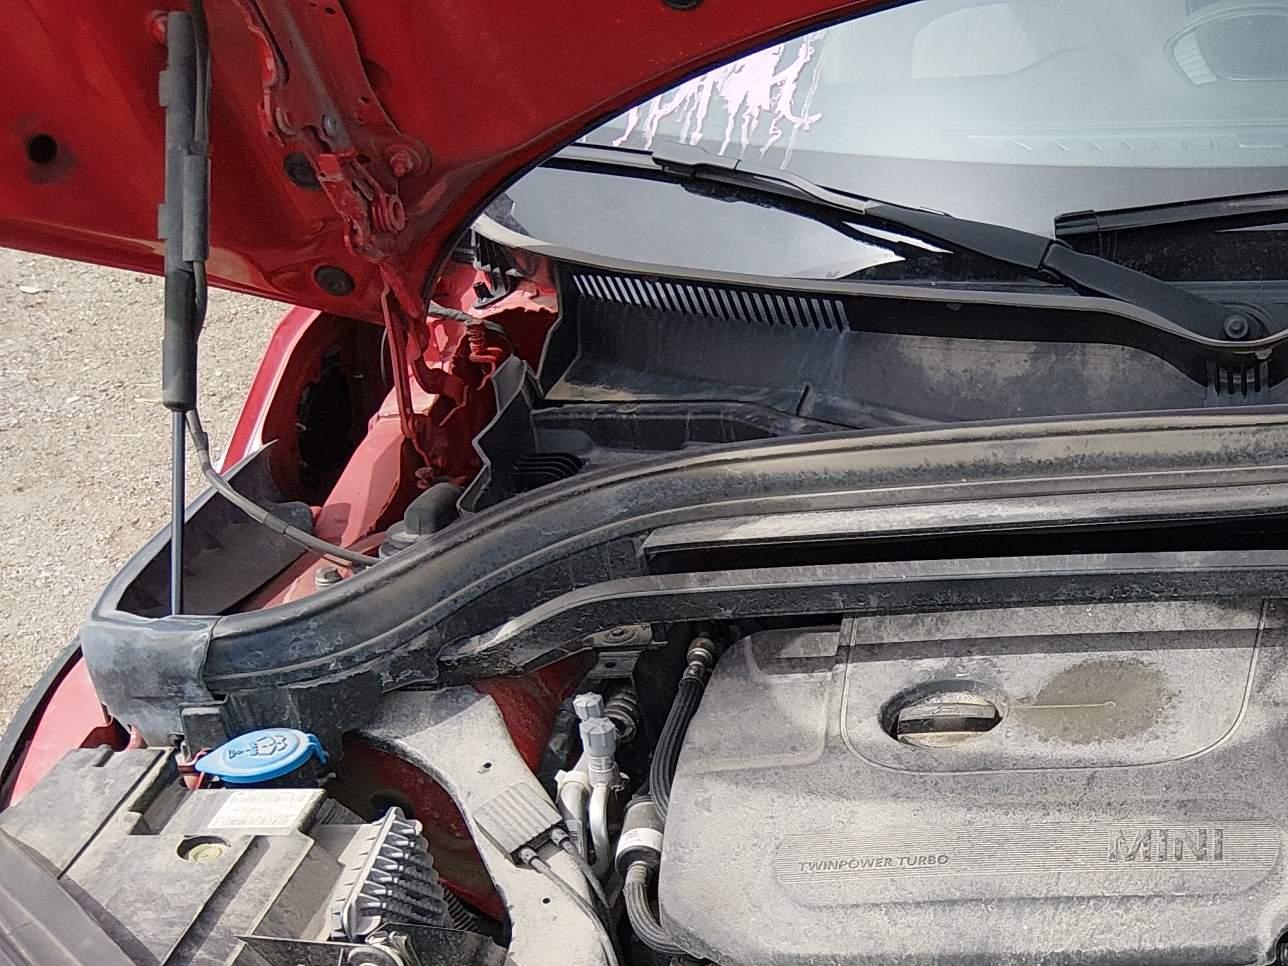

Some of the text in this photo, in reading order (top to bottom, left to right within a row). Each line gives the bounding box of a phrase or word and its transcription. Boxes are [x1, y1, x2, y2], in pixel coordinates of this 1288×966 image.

[1108, 828, 1223, 862] MINI
[799, 854, 949, 872] TWINPOWER TURBO
